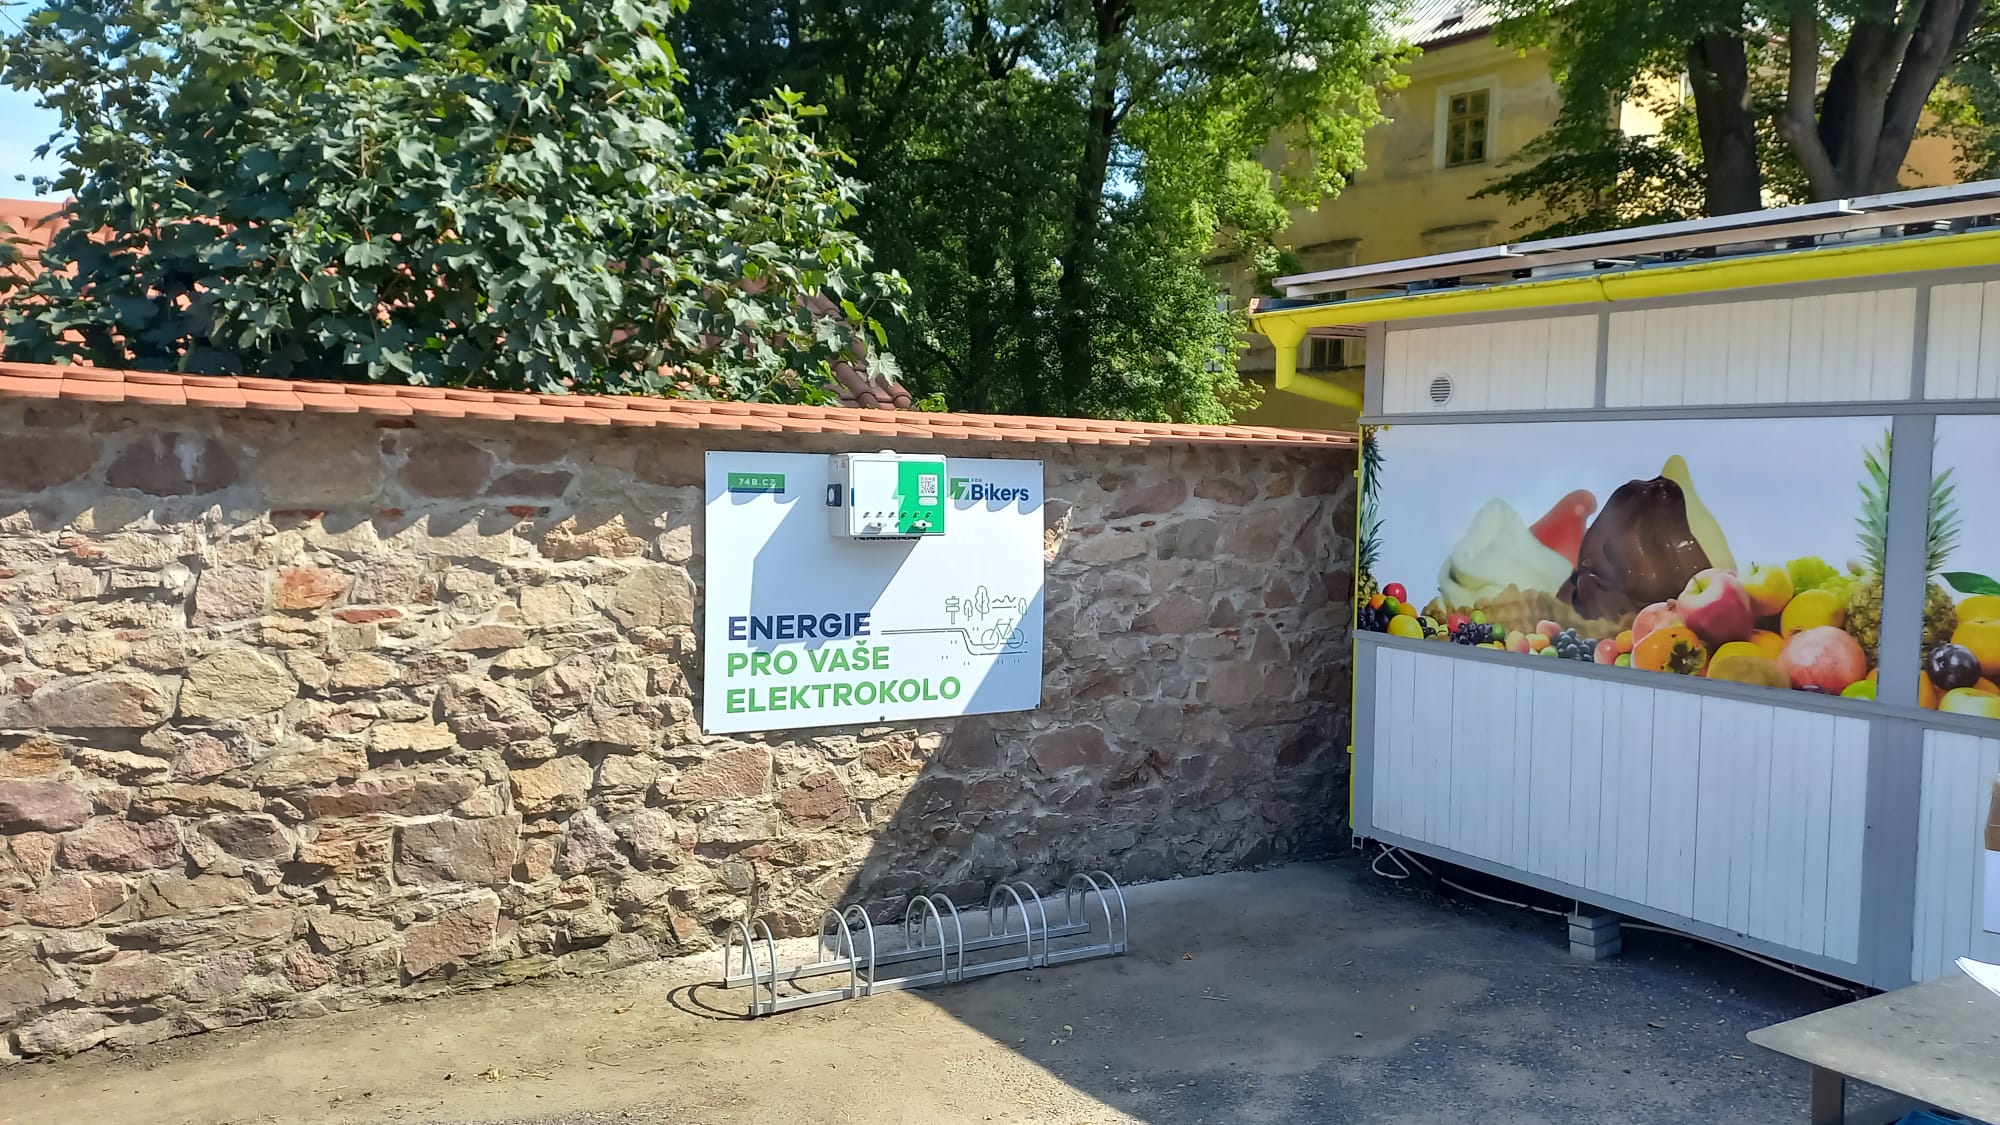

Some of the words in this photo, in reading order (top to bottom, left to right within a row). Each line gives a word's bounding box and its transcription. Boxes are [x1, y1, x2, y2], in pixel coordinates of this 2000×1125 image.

[738, 478, 776, 486] 74B.CZ
[971, 483, 1029, 501] Bikers
[728, 612, 871, 641] ENERGIE
[727, 650, 798, 677] PRO
[808, 640, 890, 673] VAŠE
[726, 676, 961, 713] ELEKTROKOLO
